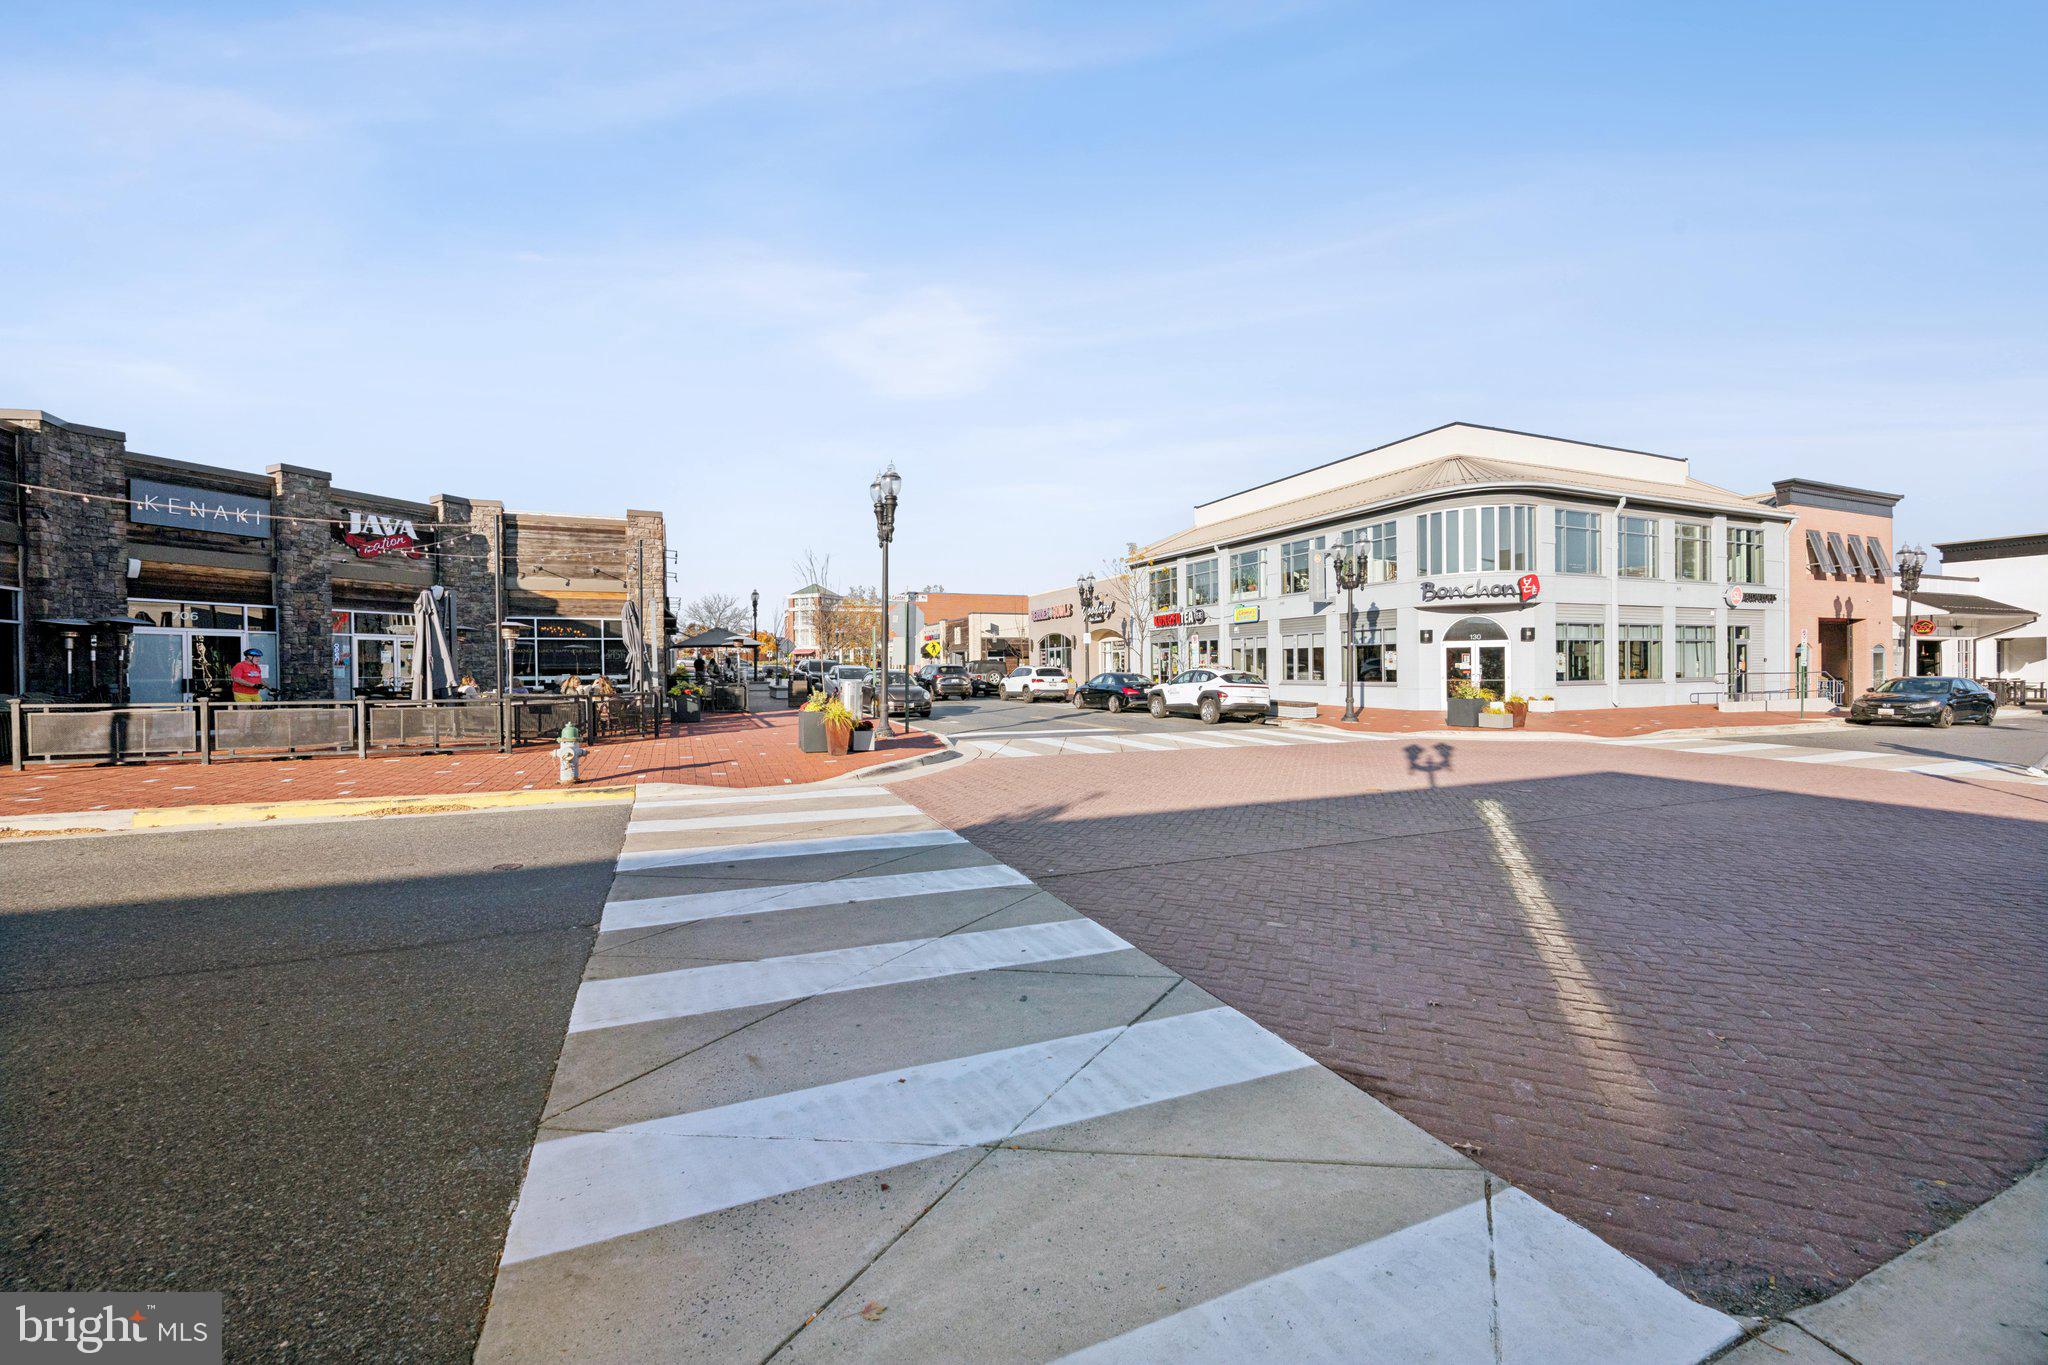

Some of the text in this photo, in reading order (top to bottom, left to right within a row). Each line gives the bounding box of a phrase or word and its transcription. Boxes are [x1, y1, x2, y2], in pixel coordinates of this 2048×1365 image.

[145, 494, 260, 525] KENAKI
[348, 512, 420, 540] JAVA
[172, 611, 199, 621] 706
[1180, 610, 1195, 624] TEA
